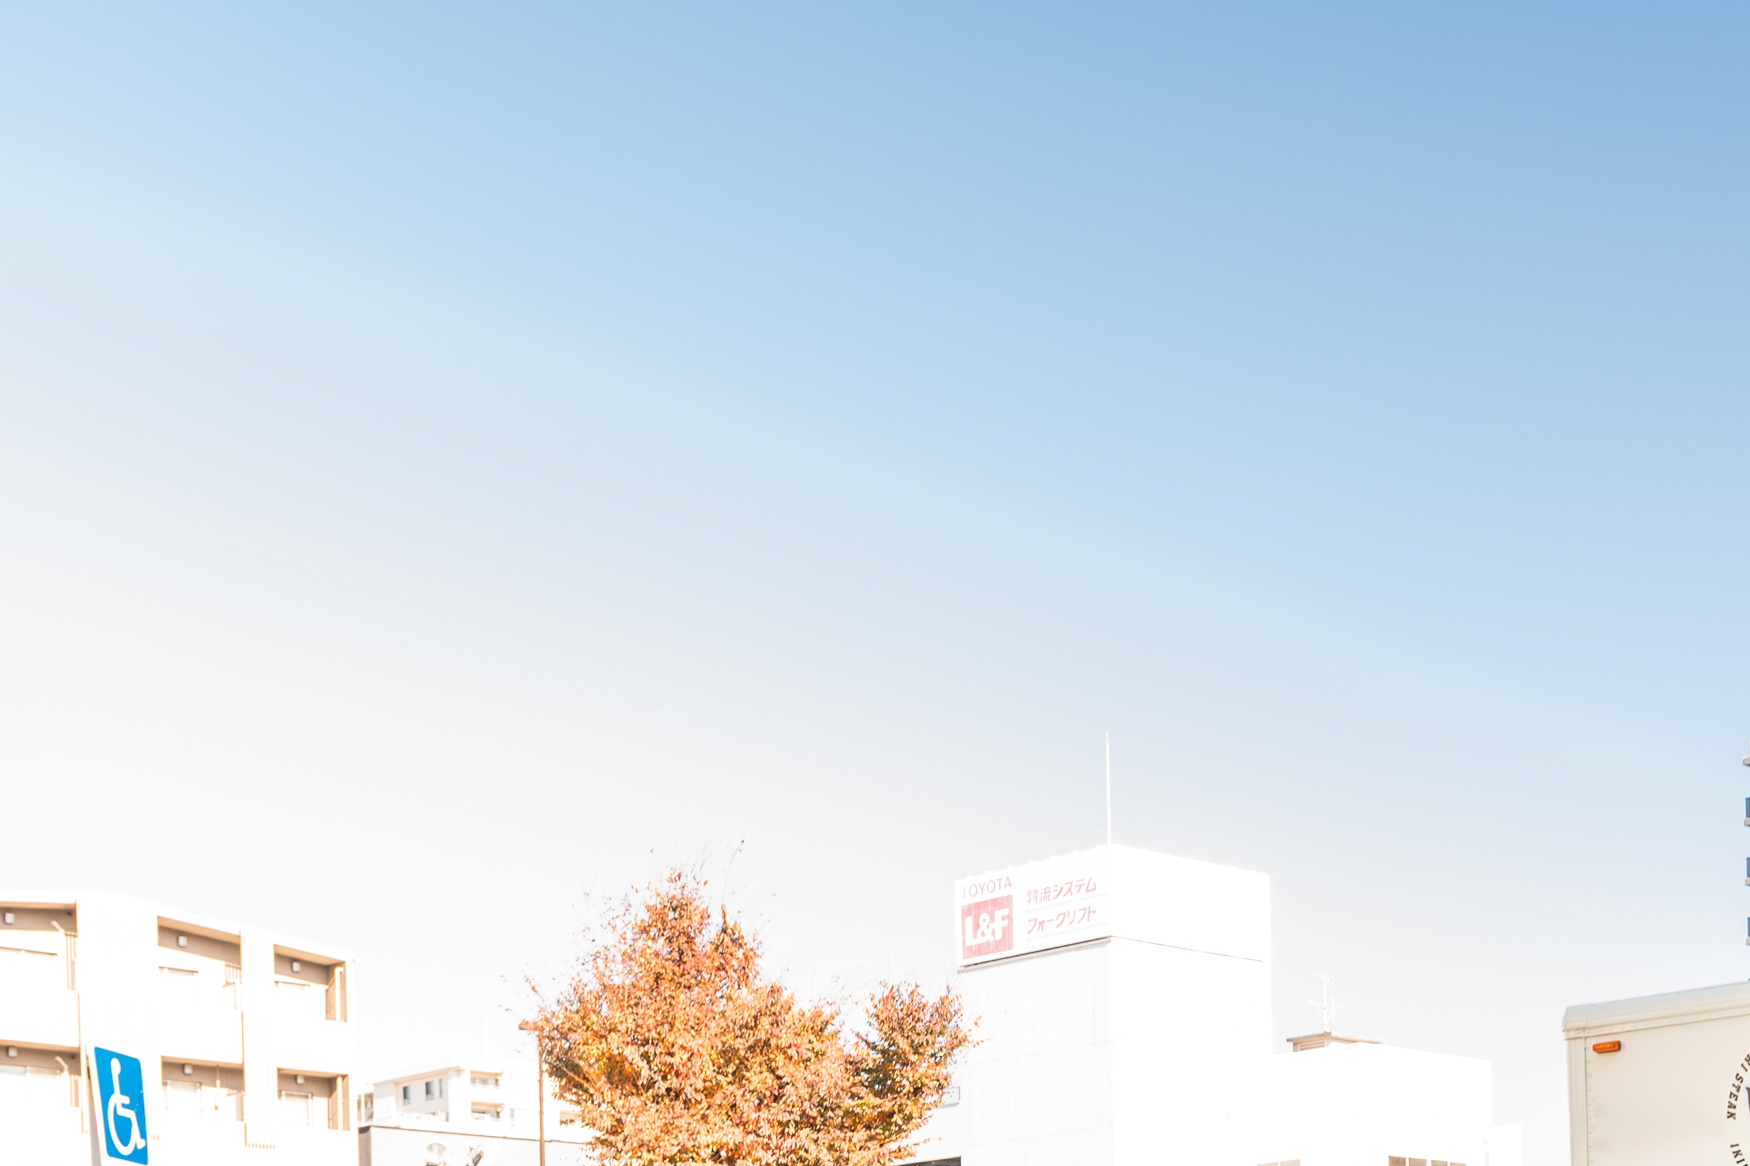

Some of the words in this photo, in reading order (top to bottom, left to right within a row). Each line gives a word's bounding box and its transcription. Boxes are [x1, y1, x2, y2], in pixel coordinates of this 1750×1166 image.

[962, 876, 1013, 899] TOYOTA
[1026, 876, 1097, 906] 物流システム
[964, 907, 1010, 947] L&F
[1027, 905, 1097, 935] フォークリフト
